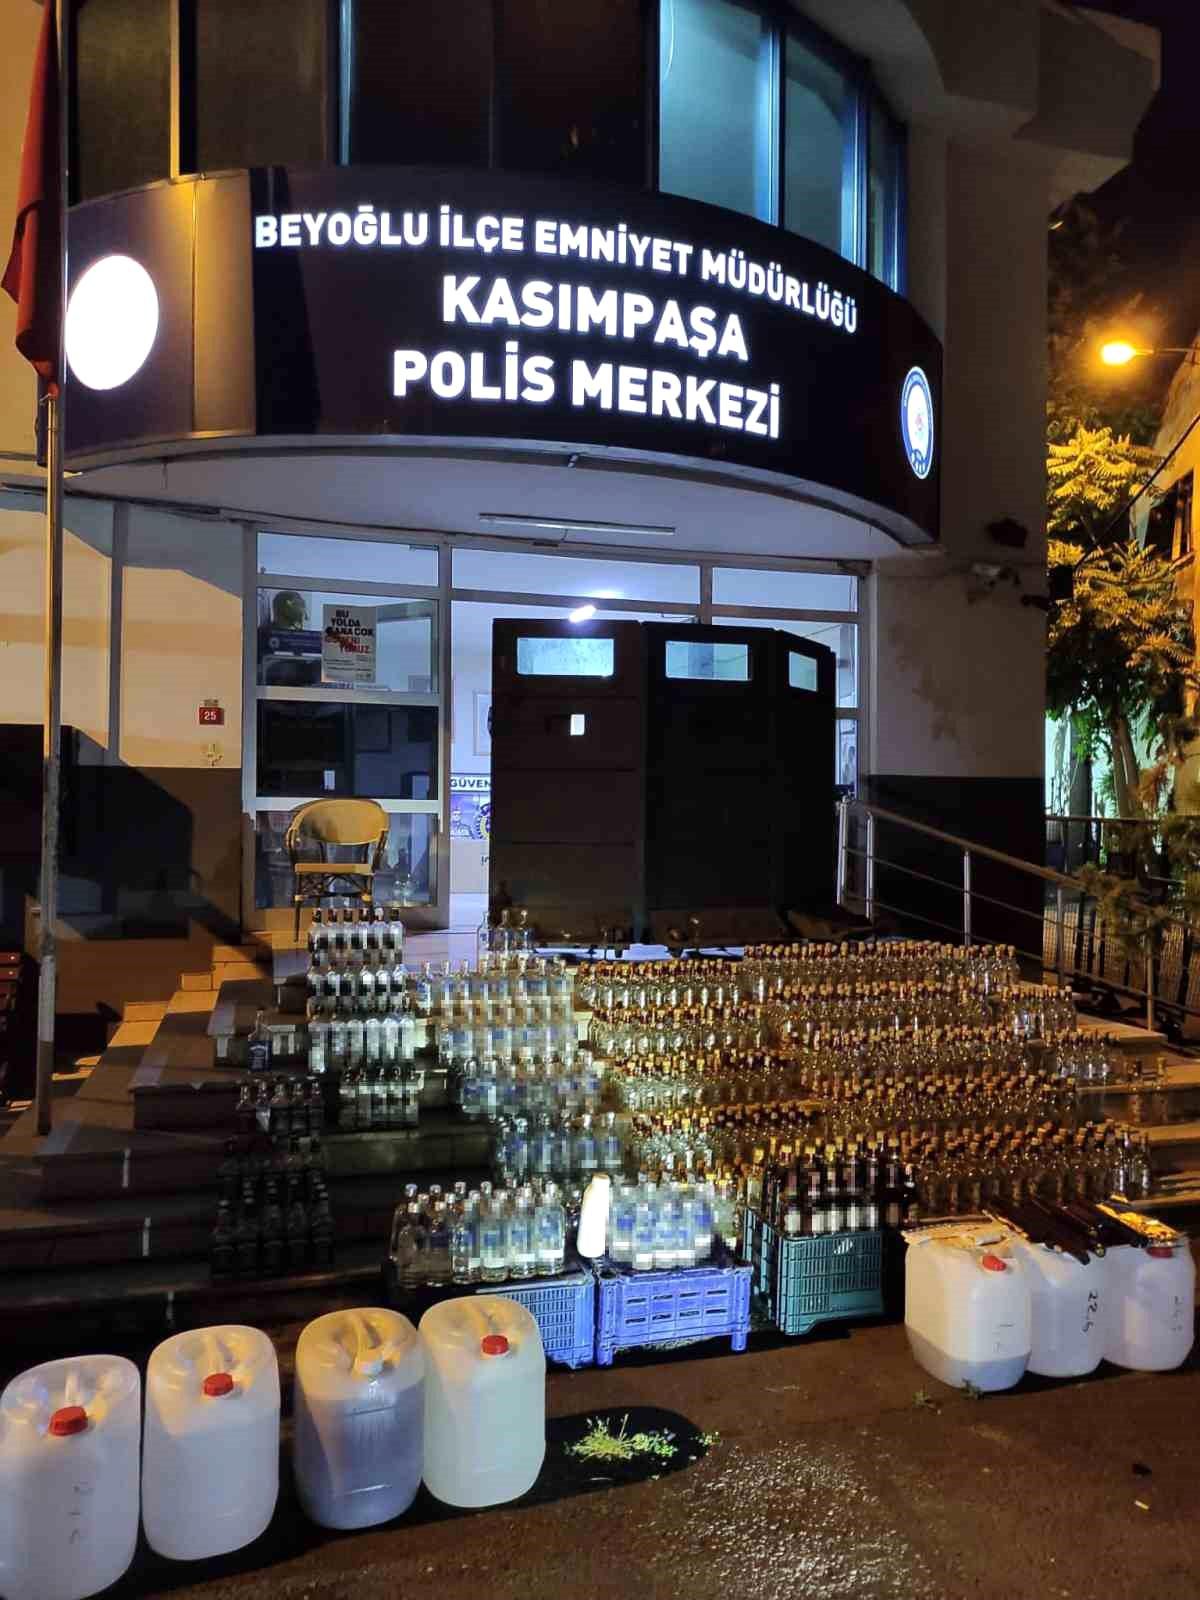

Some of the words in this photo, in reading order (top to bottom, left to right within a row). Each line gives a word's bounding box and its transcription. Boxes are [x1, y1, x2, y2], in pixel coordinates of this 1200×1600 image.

[255, 204, 429, 248] BEYOĞLU
[439, 204, 524, 254] İLÇE
[534, 219, 694, 276] EMNİYET
[701, 248, 857, 334] MÜDÜRLÜĞÜ
[442, 274, 749, 362] KASIMPAŞA
[393, 340, 555, 403] POLİS
[571, 359, 780, 439] MERKEZİ
[204, 711, 217, 721] 25
